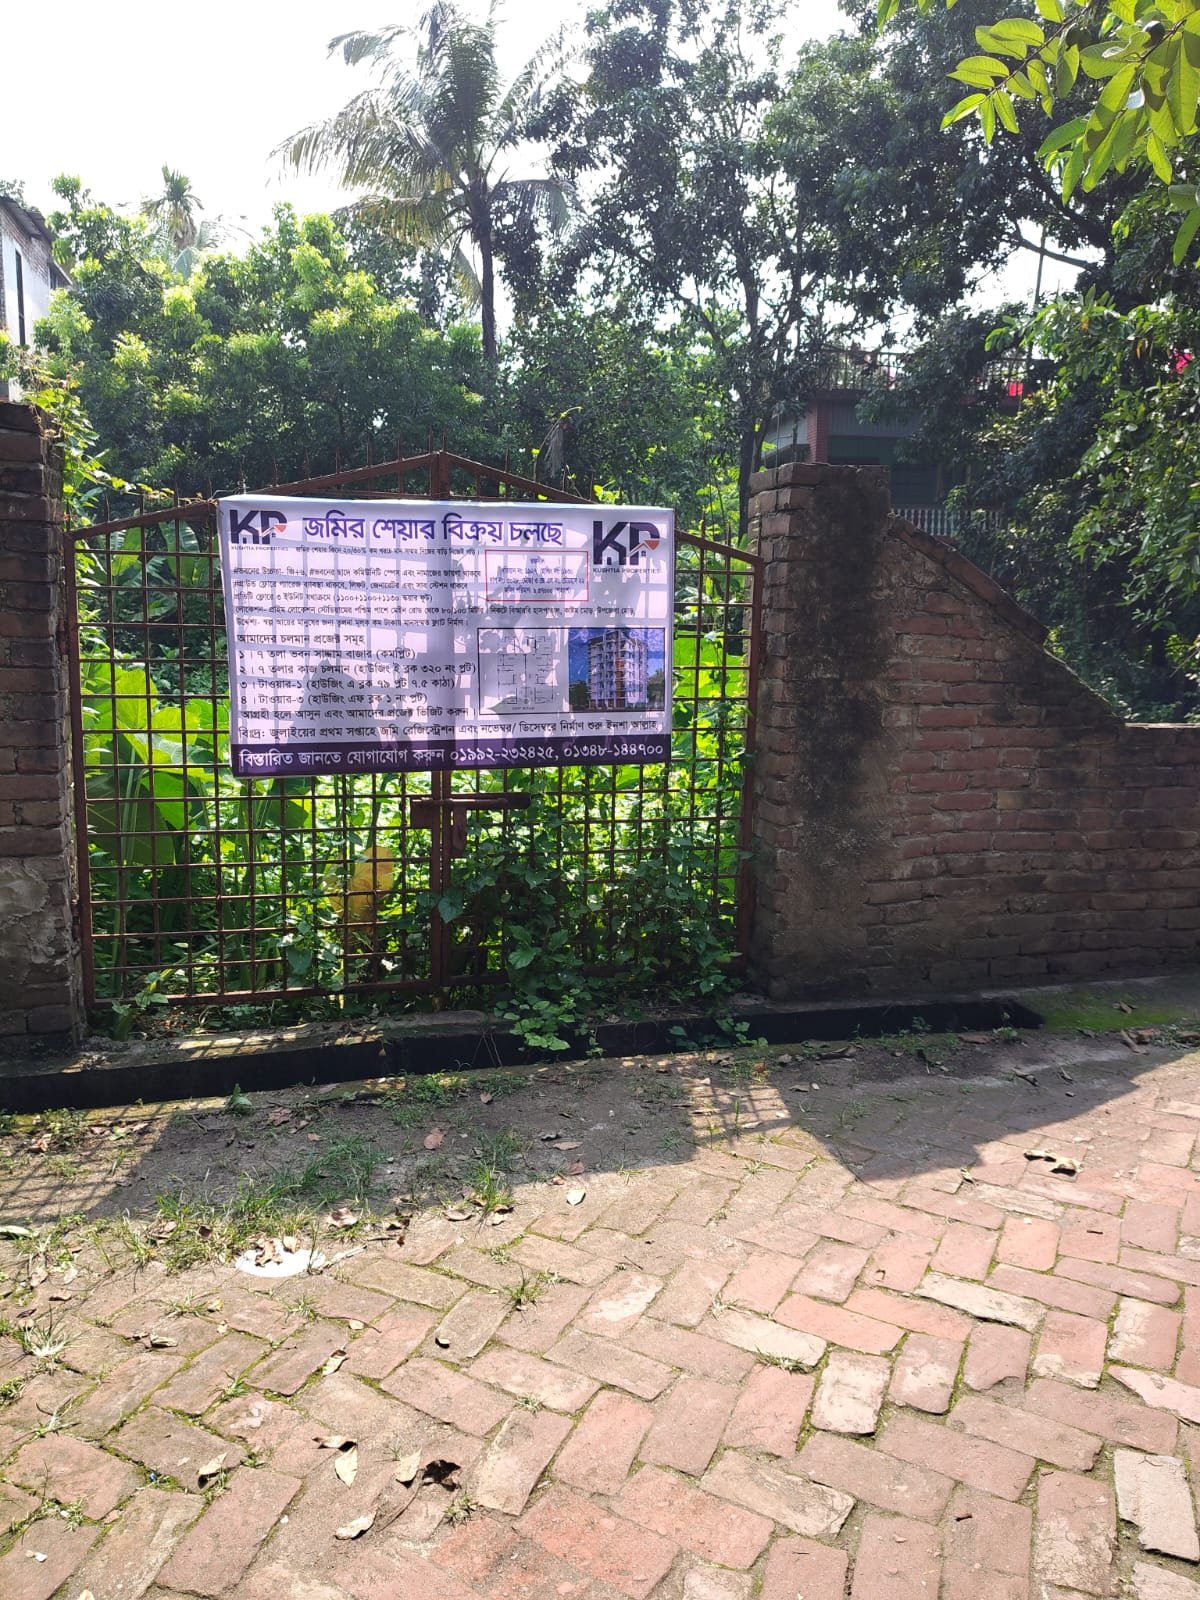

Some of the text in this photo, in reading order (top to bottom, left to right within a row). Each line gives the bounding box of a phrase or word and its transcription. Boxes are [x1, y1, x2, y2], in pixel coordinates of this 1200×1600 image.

[229, 509, 288, 545] KP
[303, 509, 564, 545] জমির শেয়ার বিক্রয় চলছে
[592, 520, 660, 566] KP
[236, 633, 365, 646] আমাদের চলমান প্রজেক্ট সমূহ
[266, 650, 286, 658] তলা
[290, 650, 310, 658] ভবন
[314, 650, 342, 659] সাদ্দাম
[346, 650, 372, 659] বাজার
[268, 665, 294, 674] তলার
[297, 665, 317, 673] কাজ
[320, 665, 349, 674] চলমান
[421, 665, 442, 673] ৩২০
[444, 664, 456, 673] নং
[257, 679, 302, 689] টাওয়ার-১
[411, 679, 428, 689] ৭.৫
[258, 693, 305, 704] টাওয়ার-৩
[347, 694, 365, 703] এফ
[240, 708, 269, 720] আগ্রহী
[273, 710, 292, 719] হলে
[295, 710, 320, 720] আসুন
[324, 710, 345, 719] এবং
[346, 709, 384, 719] আমাদের
[387, 707, 413, 718] প্রজেক্ট
[416, 705, 443, 717] ভিজিট
[446, 707, 469, 717] করুন
[268, 727, 316, 740] জুলাইয়ের
[320, 727, 343, 738] প্রথম
[346, 727, 377, 737] সপ্তাহে
[379, 723, 399, 736] জমি
[403, 723, 455, 737] রেজিস্ট্রেশন
[459, 725, 478, 734] এবং
[519, 721, 557, 733] ডিসেম্বরে
[560, 720, 584, 732] নির্মাণ
[588, 721, 603, 731] শুরু
[605, 719, 628, 731] ইনশা
[238, 748, 294, 767] বিস্তারিত
[298, 750, 342, 766] জানতে
[347, 749, 408, 765] যোগাযোগ
[411, 748, 445, 764] করুন
[563, 743, 663, 758] ০১৩৪৮-১৪৪৭০০
